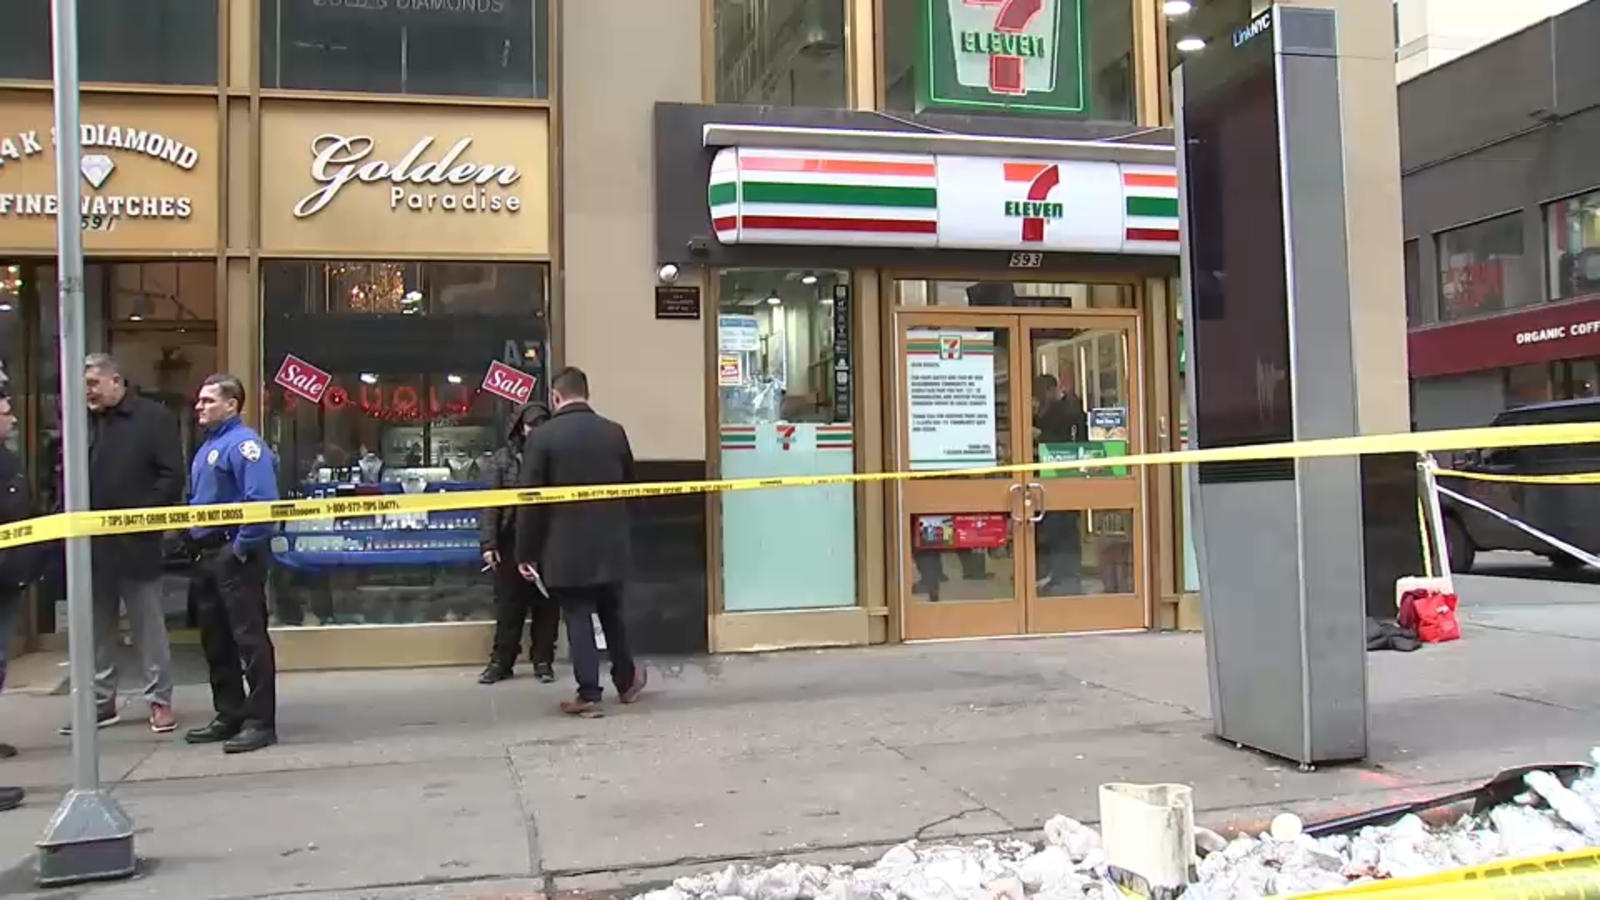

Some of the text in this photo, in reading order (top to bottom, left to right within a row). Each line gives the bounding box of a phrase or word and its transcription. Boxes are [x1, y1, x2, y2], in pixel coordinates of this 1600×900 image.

[80, 123, 199, 170] DIAMOND
[293, 133, 522, 218] Golden
[0, 193, 57, 214] FINE
[391, 186, 521, 211] Paradise
[1003, 163, 1060, 242] 7
[1010, 252, 1042, 268] 593
[1515, 325, 1566, 345] ORGANIC
[280, 364, 323, 395] Sale
[487, 369, 529, 398] Sale
